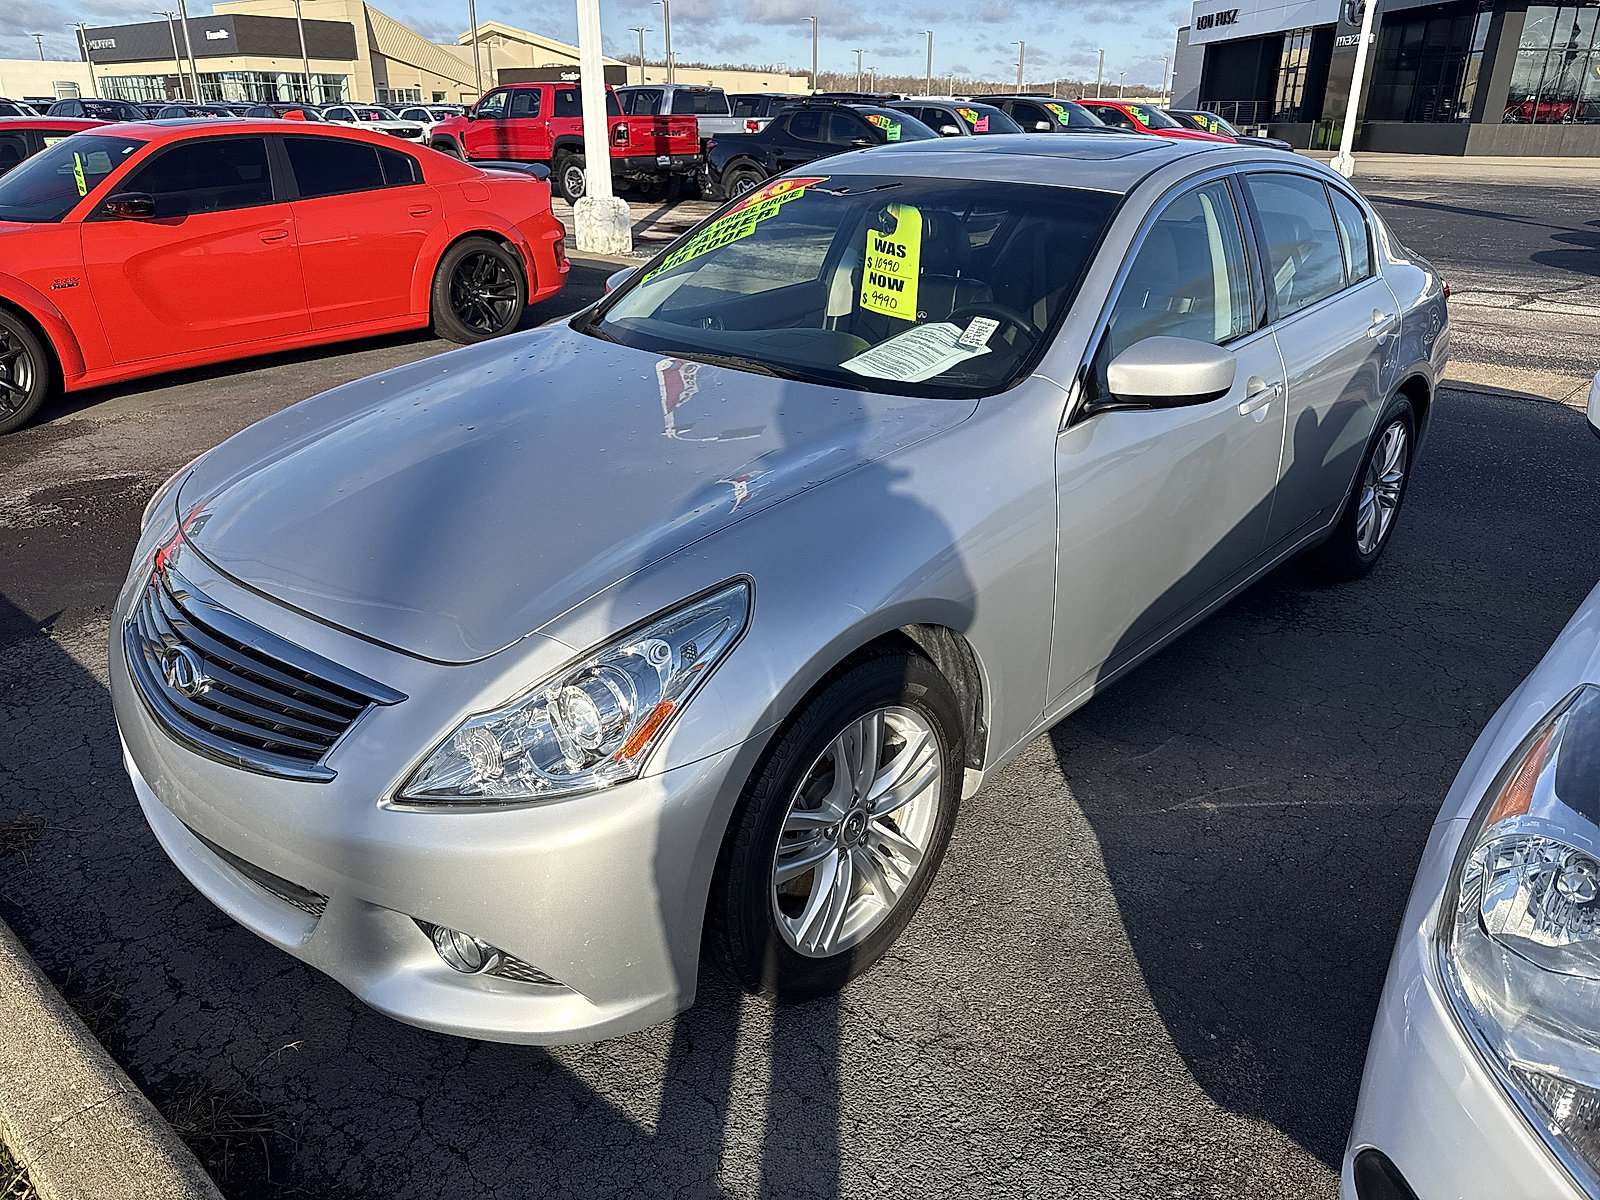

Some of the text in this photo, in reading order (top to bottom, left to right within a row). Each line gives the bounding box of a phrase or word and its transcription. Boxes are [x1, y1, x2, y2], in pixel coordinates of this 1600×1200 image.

[1196, 9, 1240, 30] LOU FUSZ
[715, 207, 758, 229] WHEEL
[760, 188, 802, 209] DRIVE
[668, 207, 778, 260] LEATHER
[646, 225, 752, 280] SUN ROOF
[874, 238, 906, 258] WAS
[867, 256, 900, 273] $ 10990
[868, 271, 905, 292] NOW
[862, 290, 898, 309] $ 9990
